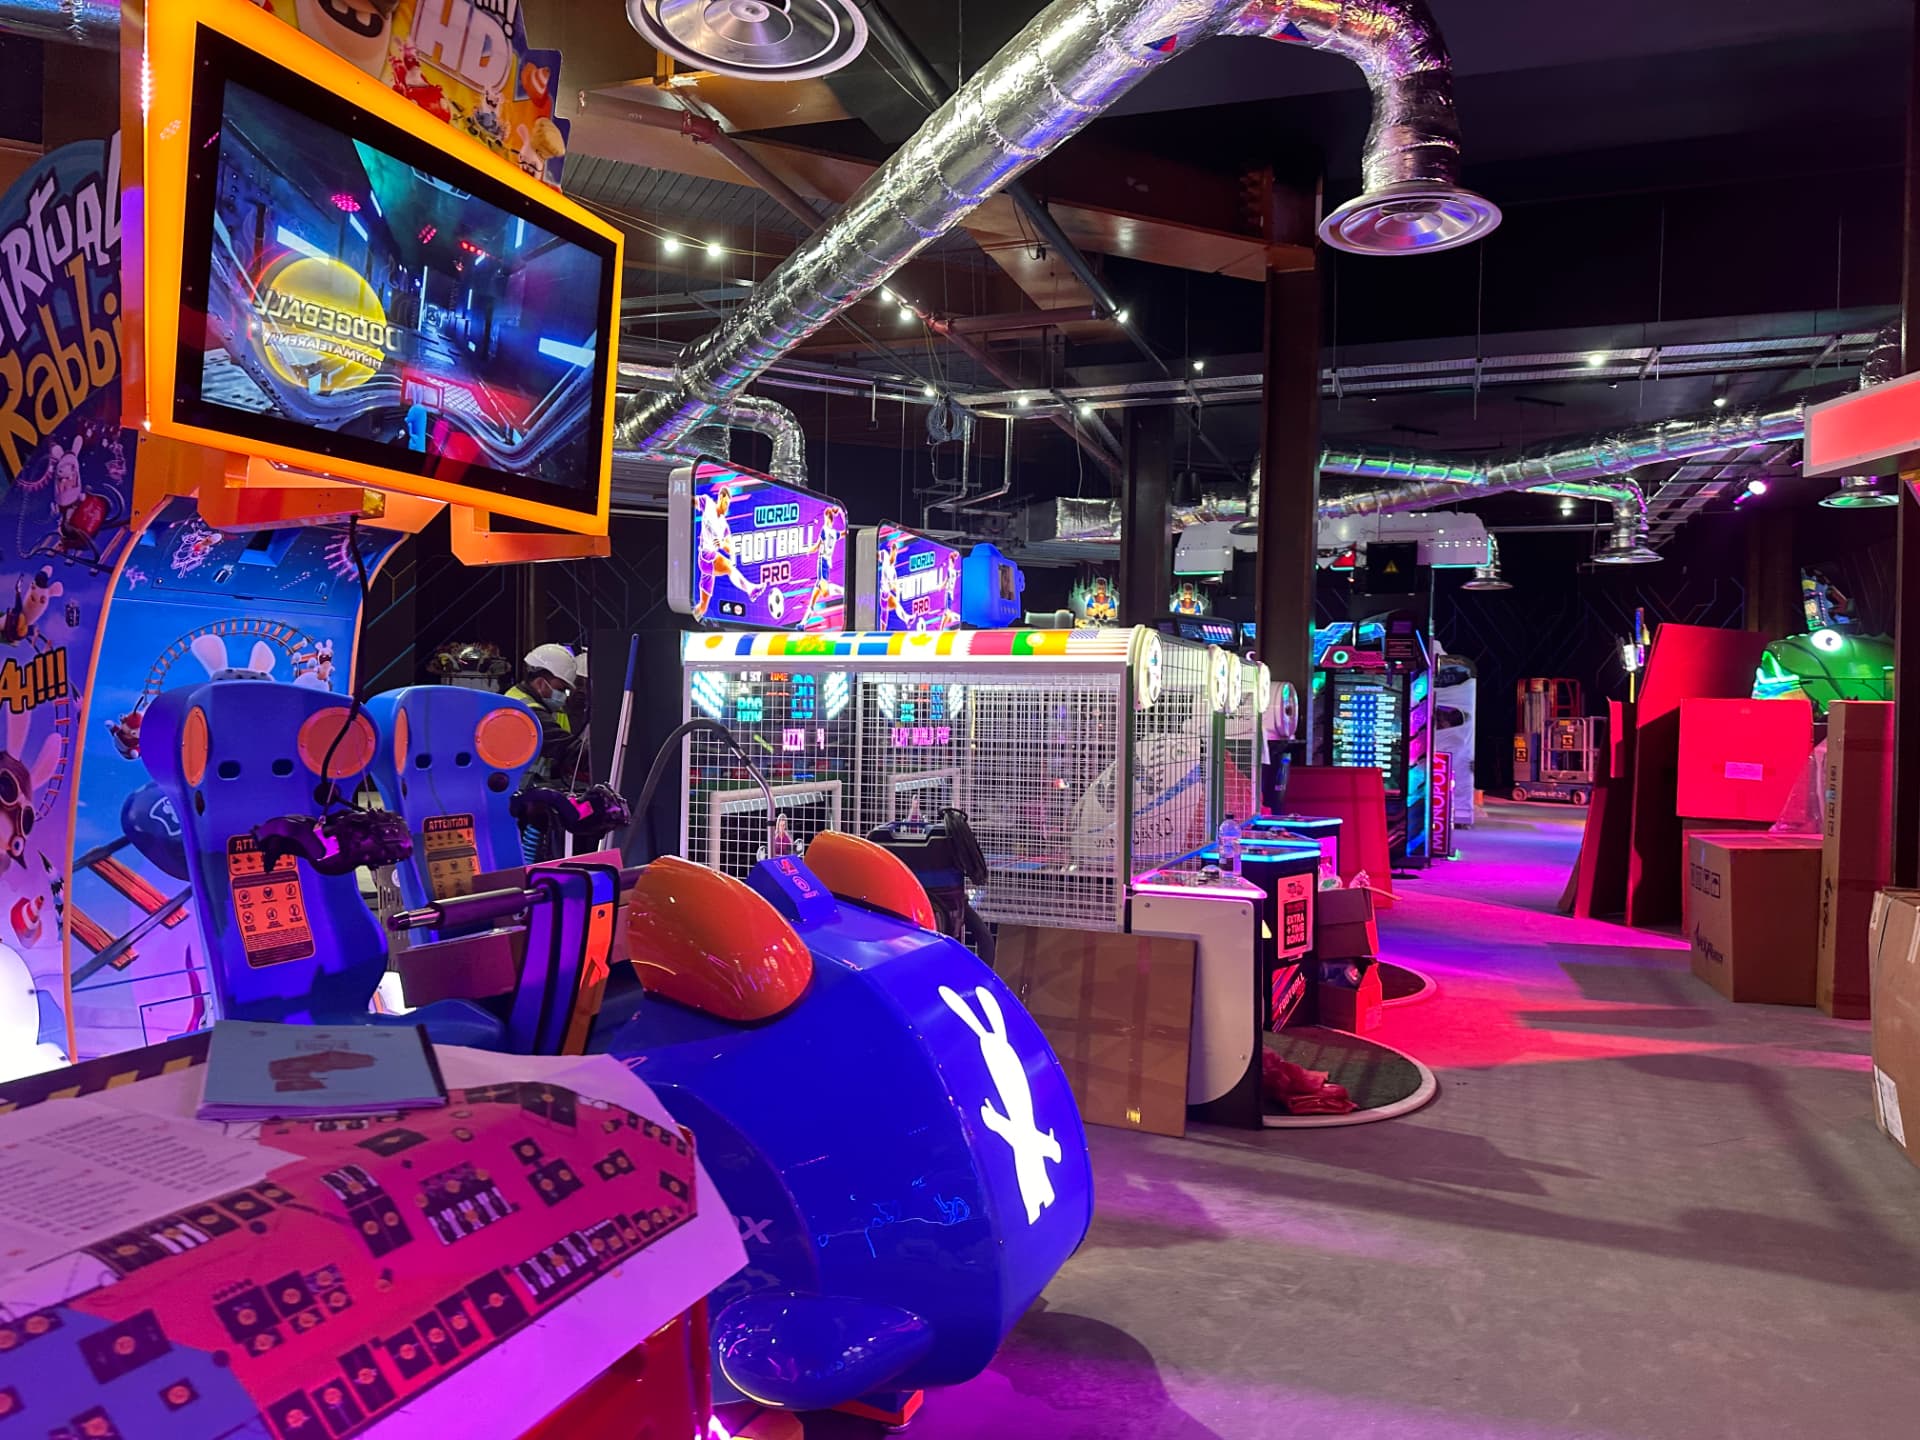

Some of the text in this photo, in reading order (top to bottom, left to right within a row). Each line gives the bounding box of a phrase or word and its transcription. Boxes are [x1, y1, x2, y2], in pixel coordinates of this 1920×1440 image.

[412, 0, 511, 93] HD
[0, 131, 121, 346] IRTUAL
[0, 252, 121, 479] Rabbi
[755, 504, 799, 526] WORLD
[731, 524, 815, 565] FOOTBALL
[910, 553, 935, 570] WORLD
[761, 563, 790, 584] PRO
[913, 598, 930, 615] PRO
[1432, 757, 1447, 850] MONOPOLY
